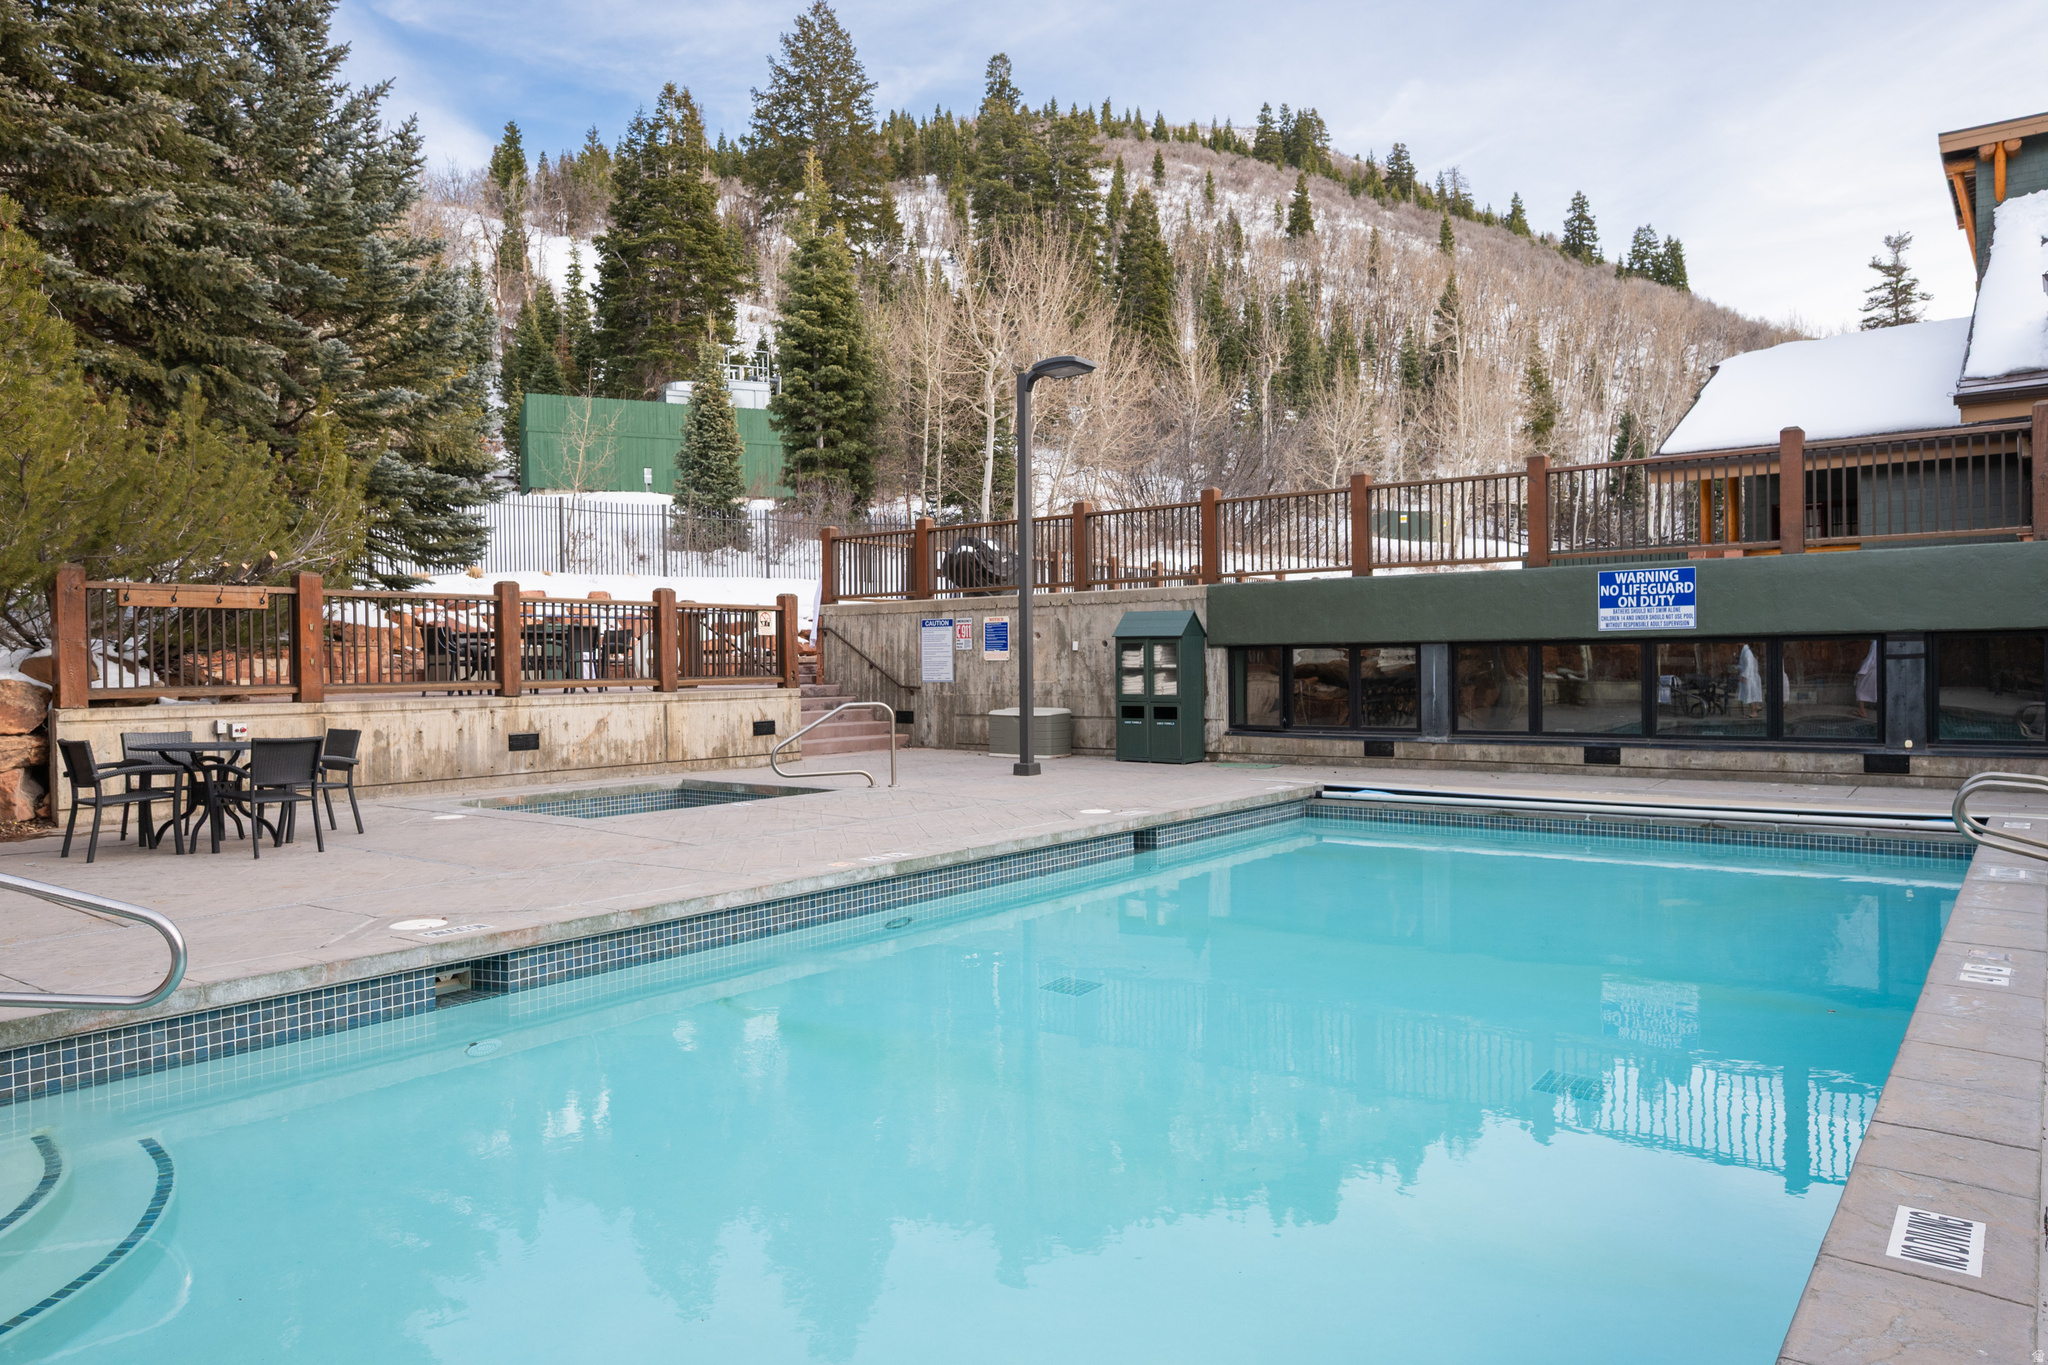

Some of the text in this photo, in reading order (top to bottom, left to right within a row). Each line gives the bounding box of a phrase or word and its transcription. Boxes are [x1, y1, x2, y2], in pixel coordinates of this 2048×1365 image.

[1615, 570, 1679, 584] WARNING
[1600, 582, 1694, 596] NO LIFEGUARD
[1618, 595, 1675, 607] ON DUTY
[961, 625, 971, 638] 911
[1900, 1211, 1973, 1271] NO DIVING
